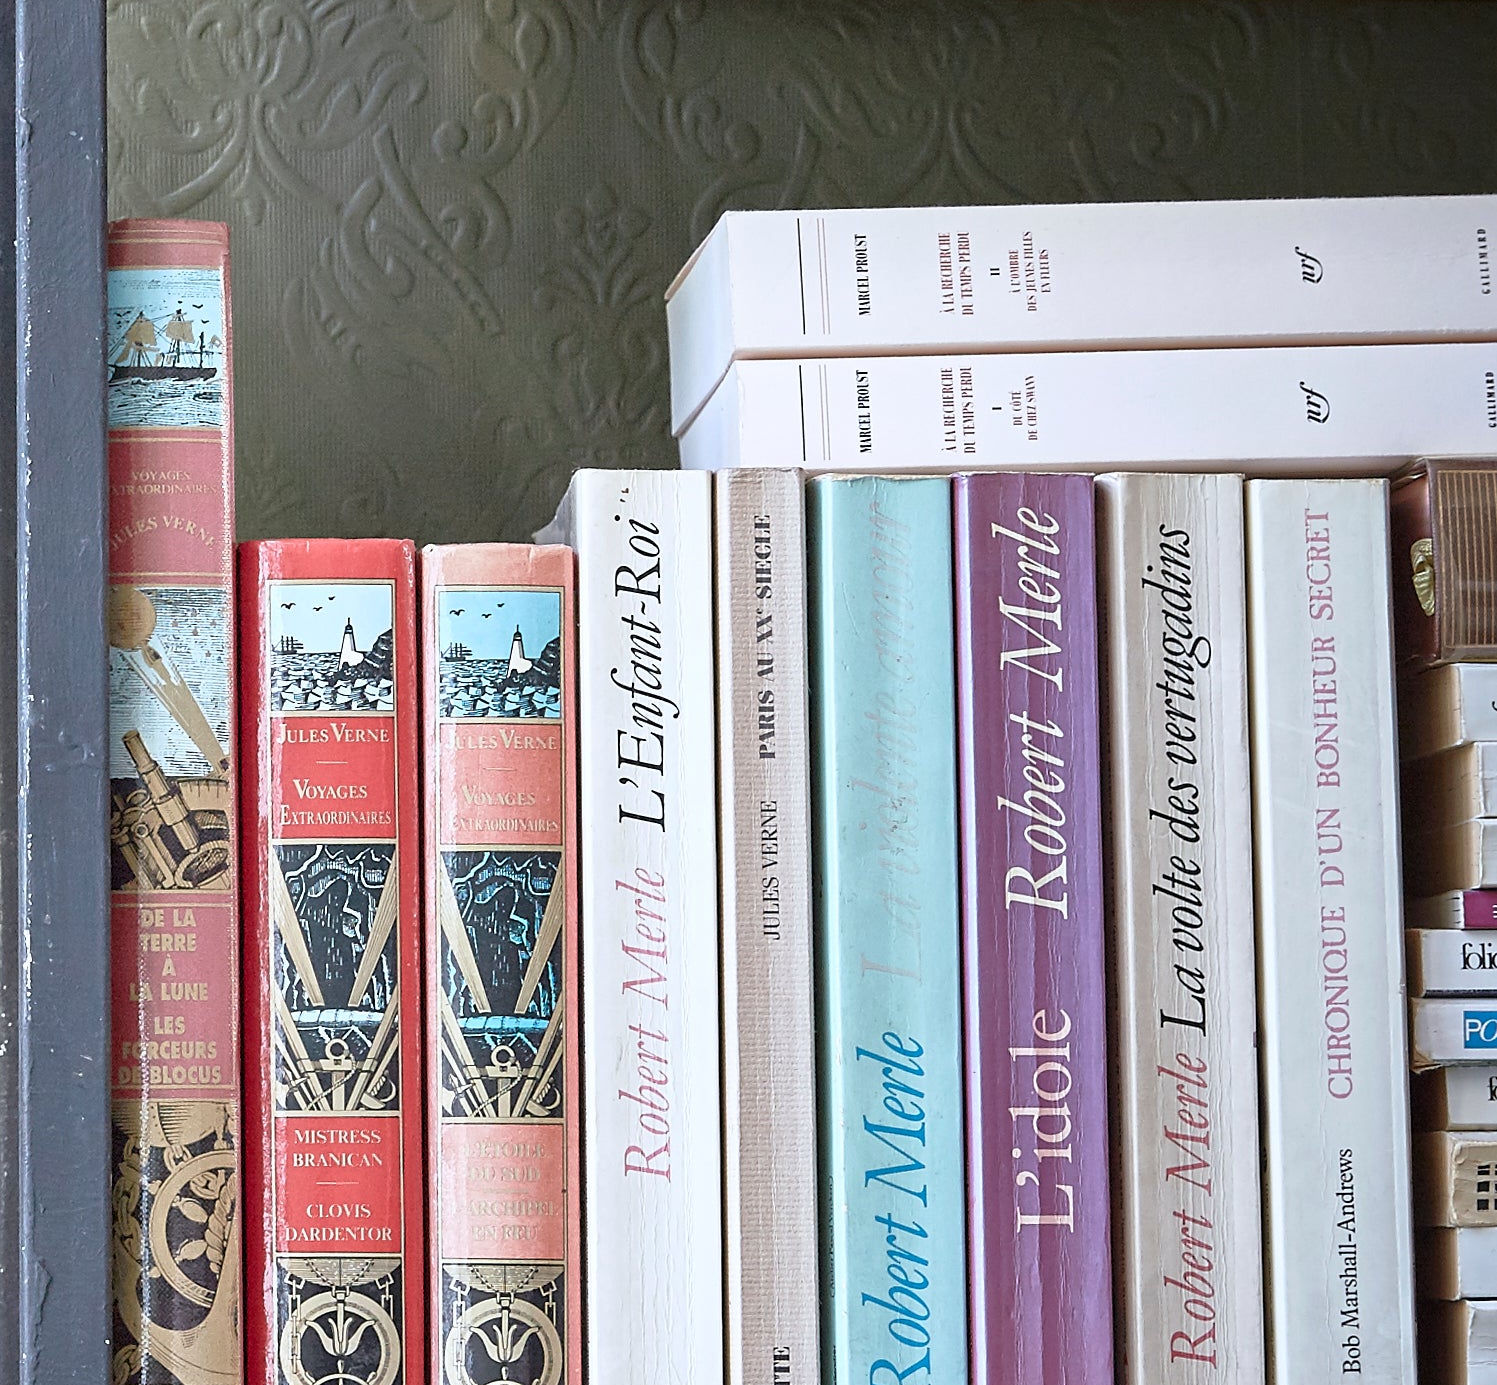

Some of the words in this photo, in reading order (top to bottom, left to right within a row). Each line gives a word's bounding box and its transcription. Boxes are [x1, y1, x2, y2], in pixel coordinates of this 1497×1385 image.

[854, 233, 869, 273] PROUST
[1294, 245, 1324, 284] nrf
[856, 275, 871, 316] MARCEL
[855, 369, 870, 409] PROUST
[1302, 381, 1330, 424] nrf
[858, 414, 872, 453] MARCEL
[997, 506, 1063, 697] Merle
[1304, 507, 1334, 621] SECRET
[610, 514, 681, 833] L'Enfant-Roi
[1141, 524, 1213, 766] vertugadins
[276, 722, 329, 746] JULES
[329, 722, 391, 744] VERNE
[1311, 635, 1343, 789] BONHEUR
[292, 778, 368, 800] VOYAGES
[996, 710, 1068, 920] Robert
[1148, 777, 1202, 843] des
[758, 799, 780, 870] VERNE
[1315, 808, 1345, 888] D'UN
[614, 867, 669, 1011] Merle
[761, 875, 782, 942] JULES
[1151, 856, 1205, 953] volte
[1159, 963, 1207, 1038] La
[1325, 906, 1354, 1099] CHRONIQUE
[294, 1128, 381, 1145] MISTRESS
[617, 1027, 671, 1184] Robert
[855, 1031, 928, 1208] Merle
[1006, 1008, 1075, 1235] L'idole
[1156, 1052, 1214, 1201] Merle
[293, 1152, 382, 1168] BRANICAN
[284, 1225, 393, 1245] DARDENTOR
[306, 1203, 371, 1218] CLOVIS
[1338, 1148, 1360, 1330] Marshall-Andrews
[1163, 1211, 1218, 1370] Robert
[1341, 1338, 1362, 1375] Bob
